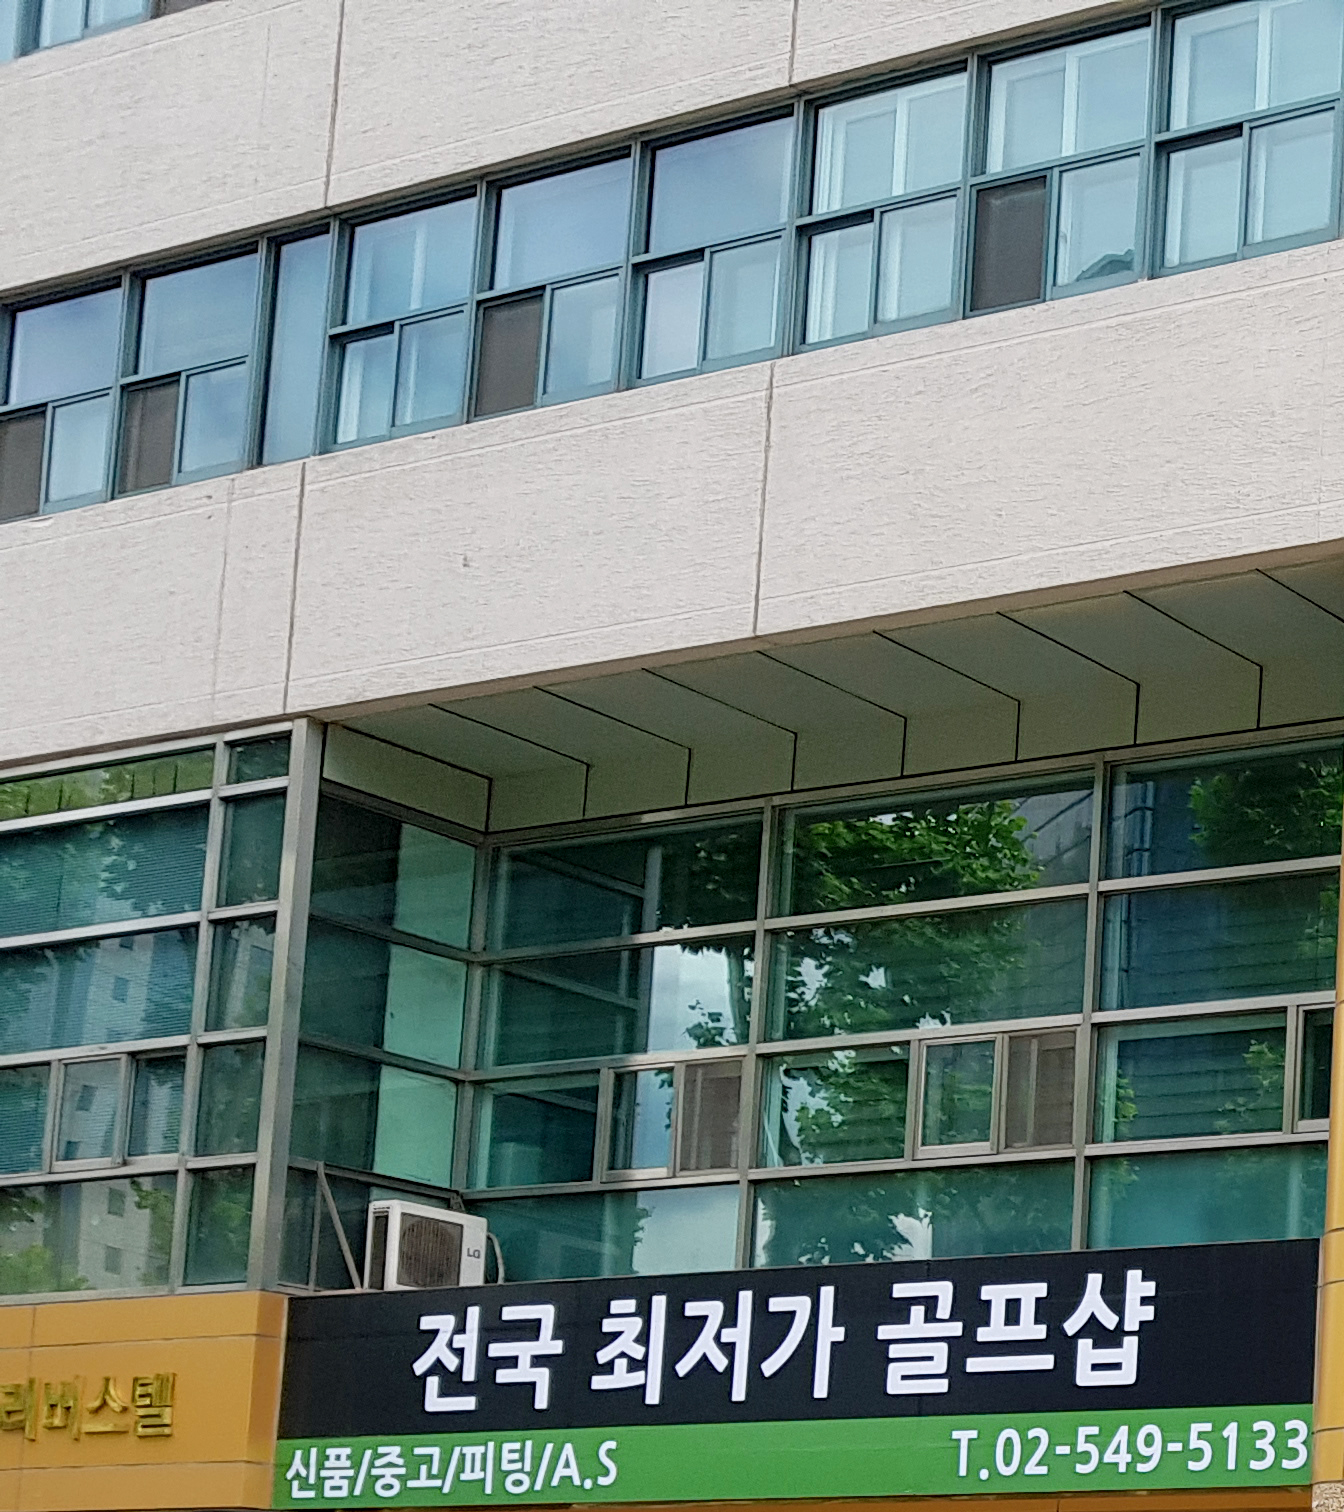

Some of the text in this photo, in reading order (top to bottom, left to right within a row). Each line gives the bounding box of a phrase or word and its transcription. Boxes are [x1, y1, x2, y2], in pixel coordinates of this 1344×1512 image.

[411, 1269, 1156, 1412] 전국 최저가 골프샵
[952, 1419, 1309, 1482] T.02-549-5133
